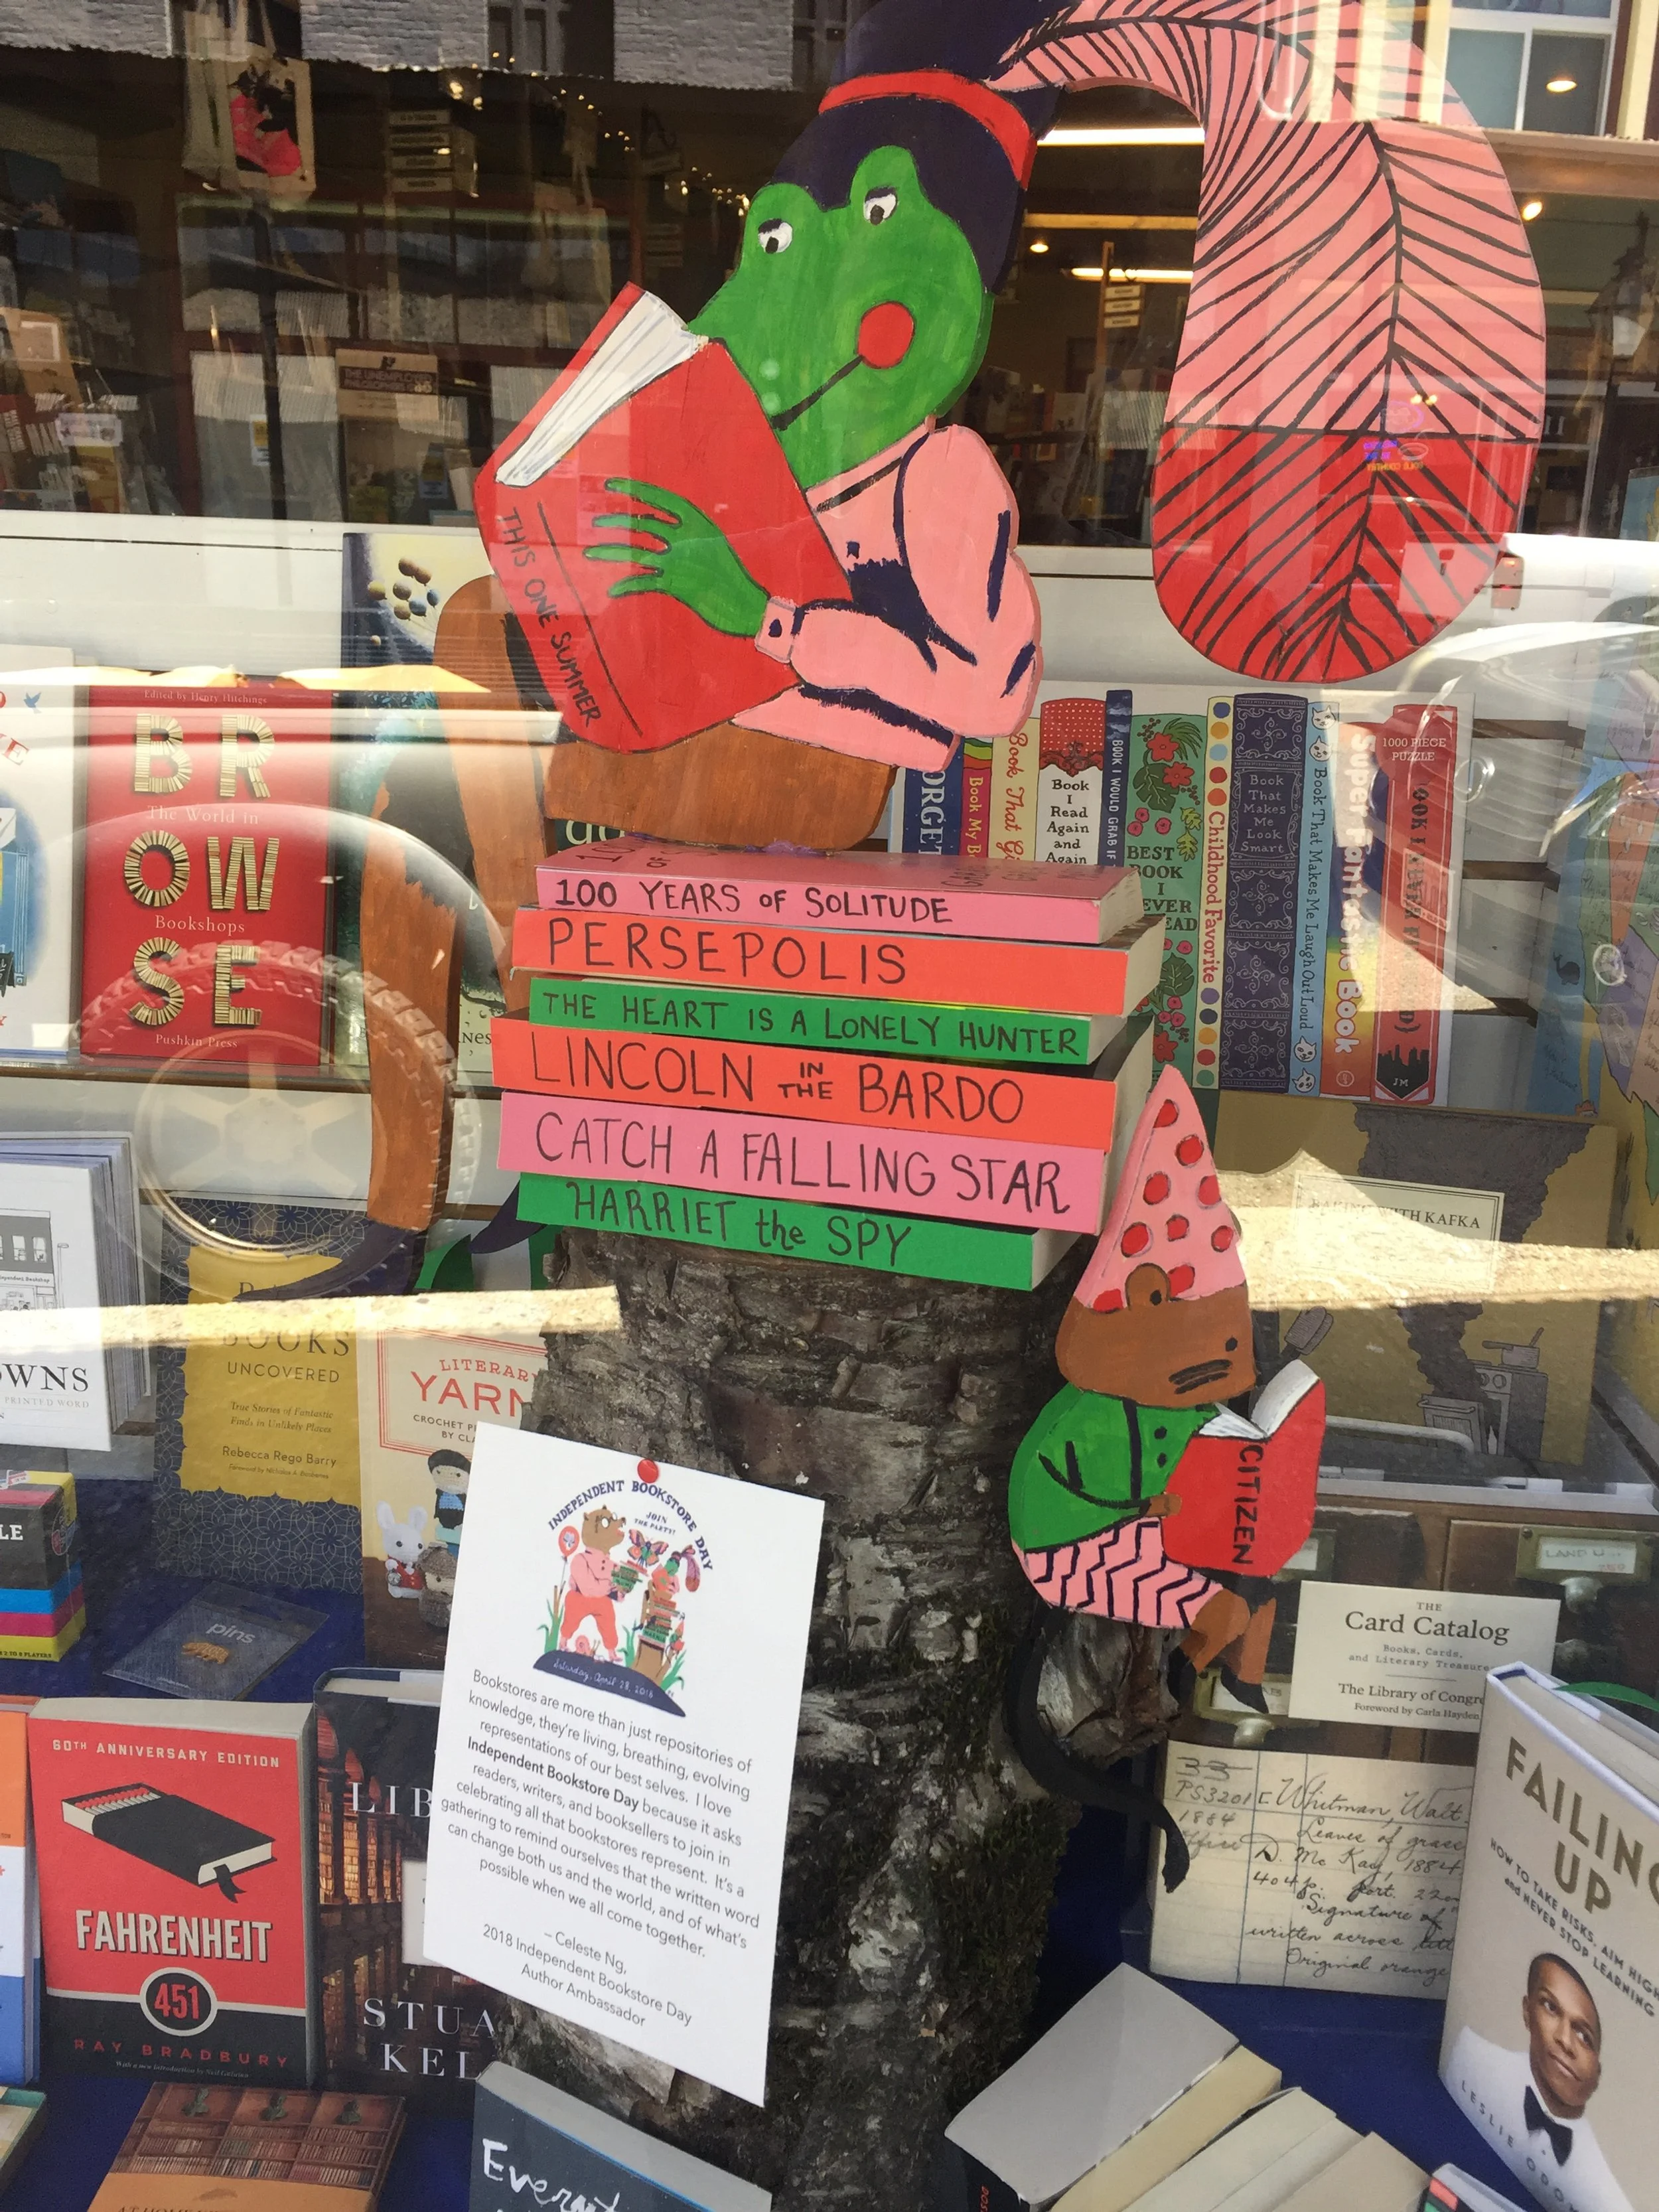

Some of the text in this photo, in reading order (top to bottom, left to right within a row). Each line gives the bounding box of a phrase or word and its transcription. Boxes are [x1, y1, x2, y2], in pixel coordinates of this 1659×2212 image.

[498, 507, 602, 728] THIS ONE SUMMER
[145, 690, 173, 700] Edited
[192, 692, 218, 703] Henry
[223, 694, 267, 705] Hitchings
[1383, 737, 1447, 748] 1000 PIECE
[1392, 751, 1435, 762] PUZZLE
[1005, 733, 1028, 832] Book That
[1052, 779, 1089, 790] Book
[1250, 775, 1283, 785] Book
[1343, 733, 1376, 819] Super
[1067, 795, 1072, 804] I
[1106, 739, 1124, 861] BOOK WOULD GRAB IF
[1249, 790, 1281, 800] That
[148, 806, 258, 824] The World in
[965, 776, 983, 840] Book My
[1050, 806, 1088, 818] Read
[1243, 804, 1286, 814] Makes
[1047, 822, 1089, 836] Again
[1247, 829, 1282, 839] Look
[1054, 840, 1080, 849] and
[1127, 846, 1175, 860] BEST
[1240, 842, 1284, 853] Smart
[1045, 852, 1087, 864] Again
[1129, 864, 1184, 879] BOOK
[1158, 883, 1165, 895] I
[1204, 810, 1225, 984] Childhood Favorite
[1300, 767, 1327, 1029] Book That Makes Me Laugh Out Loud
[555, 879, 618, 907] 100
[638, 882, 742, 913] YEARS
[806, 888, 952, 923] SOLITUDE
[1143, 899, 1192, 913] EVER
[155, 915, 245, 936] Bookshops
[548, 917, 906, 986] PERSEPOLIS
[542, 992, 1081, 1057] THE HEART IS A LONELY HUNTER
[1335, 980, 1364, 1054] Book
[156, 1035, 238, 1047] Pushkin Press
[530, 1031, 1023, 1124] LINCOLN IN THE BARDO
[536, 1112, 1070, 1215] CATCH A FALLING STAR
[566, 1182, 911, 1266] HARRIET the SPY
[1425, 1211, 1480, 1228] KAFKA
[228, 1361, 339, 1382] UNCOVERED
[5, 1396, 89, 1408] PRINTED WORD
[231, 1401, 333, 1418] True Stories of Fantastic
[231, 1416, 253, 1426] Finds
[268, 1420, 303, 1431] Unlikely
[306, 1423, 332, 1433] Places
[413, 1415, 463, 1430] CROCHET
[222, 1446, 336, 1468] Rebecca Rego Barry
[1232, 1444, 1263, 1565] CITIZEN
[549, 1481, 712, 1570] INDEPENDENT BOOKSTORE DAY
[634, 1518, 648, 1528] THE
[646, 1512, 667, 1524] JOIN
[1417, 1602, 1442, 1611] THE
[206, 1623, 255, 1643] pins
[1345, 1611, 1510, 1646] Card Catalog
[1384, 1645, 1463, 1658] Books, Cards,
[1349, 1654, 1429, 1668] and Literary
[595, 1672, 616, 1686] April
[1338, 1683, 1436, 1701] The Library of
[1354, 1703, 1398, 1714] Foreword
[1402, 1707, 1412, 1716] by
[1415, 1708, 1440, 1718] Carla
[53, 1740, 279, 1767] 60TH ANNIVERSARY EDITION
[469, 1690, 750, 1801] knowledge, they're living, breathing, evolving
[1555, 1840, 1611, 1913] UP
[1302, 1893, 1411, 1926] Signature
[1490, 1838, 1624, 1970] HOW TO TAKE RISKS, AIM
[76, 1909, 273, 1962] FAHRENHEIT
[1246, 1928, 1321, 1941] written
[1504, 1877, 1655, 2017] and NEVER STOP LEARNING
[1285, 1949, 1372, 1978] Original
[154, 1982, 198, 2020] 451
[74, 2039, 287, 2067] RAY BRADBURY
[1462, 2080, 1513, 2148] LESLIE
